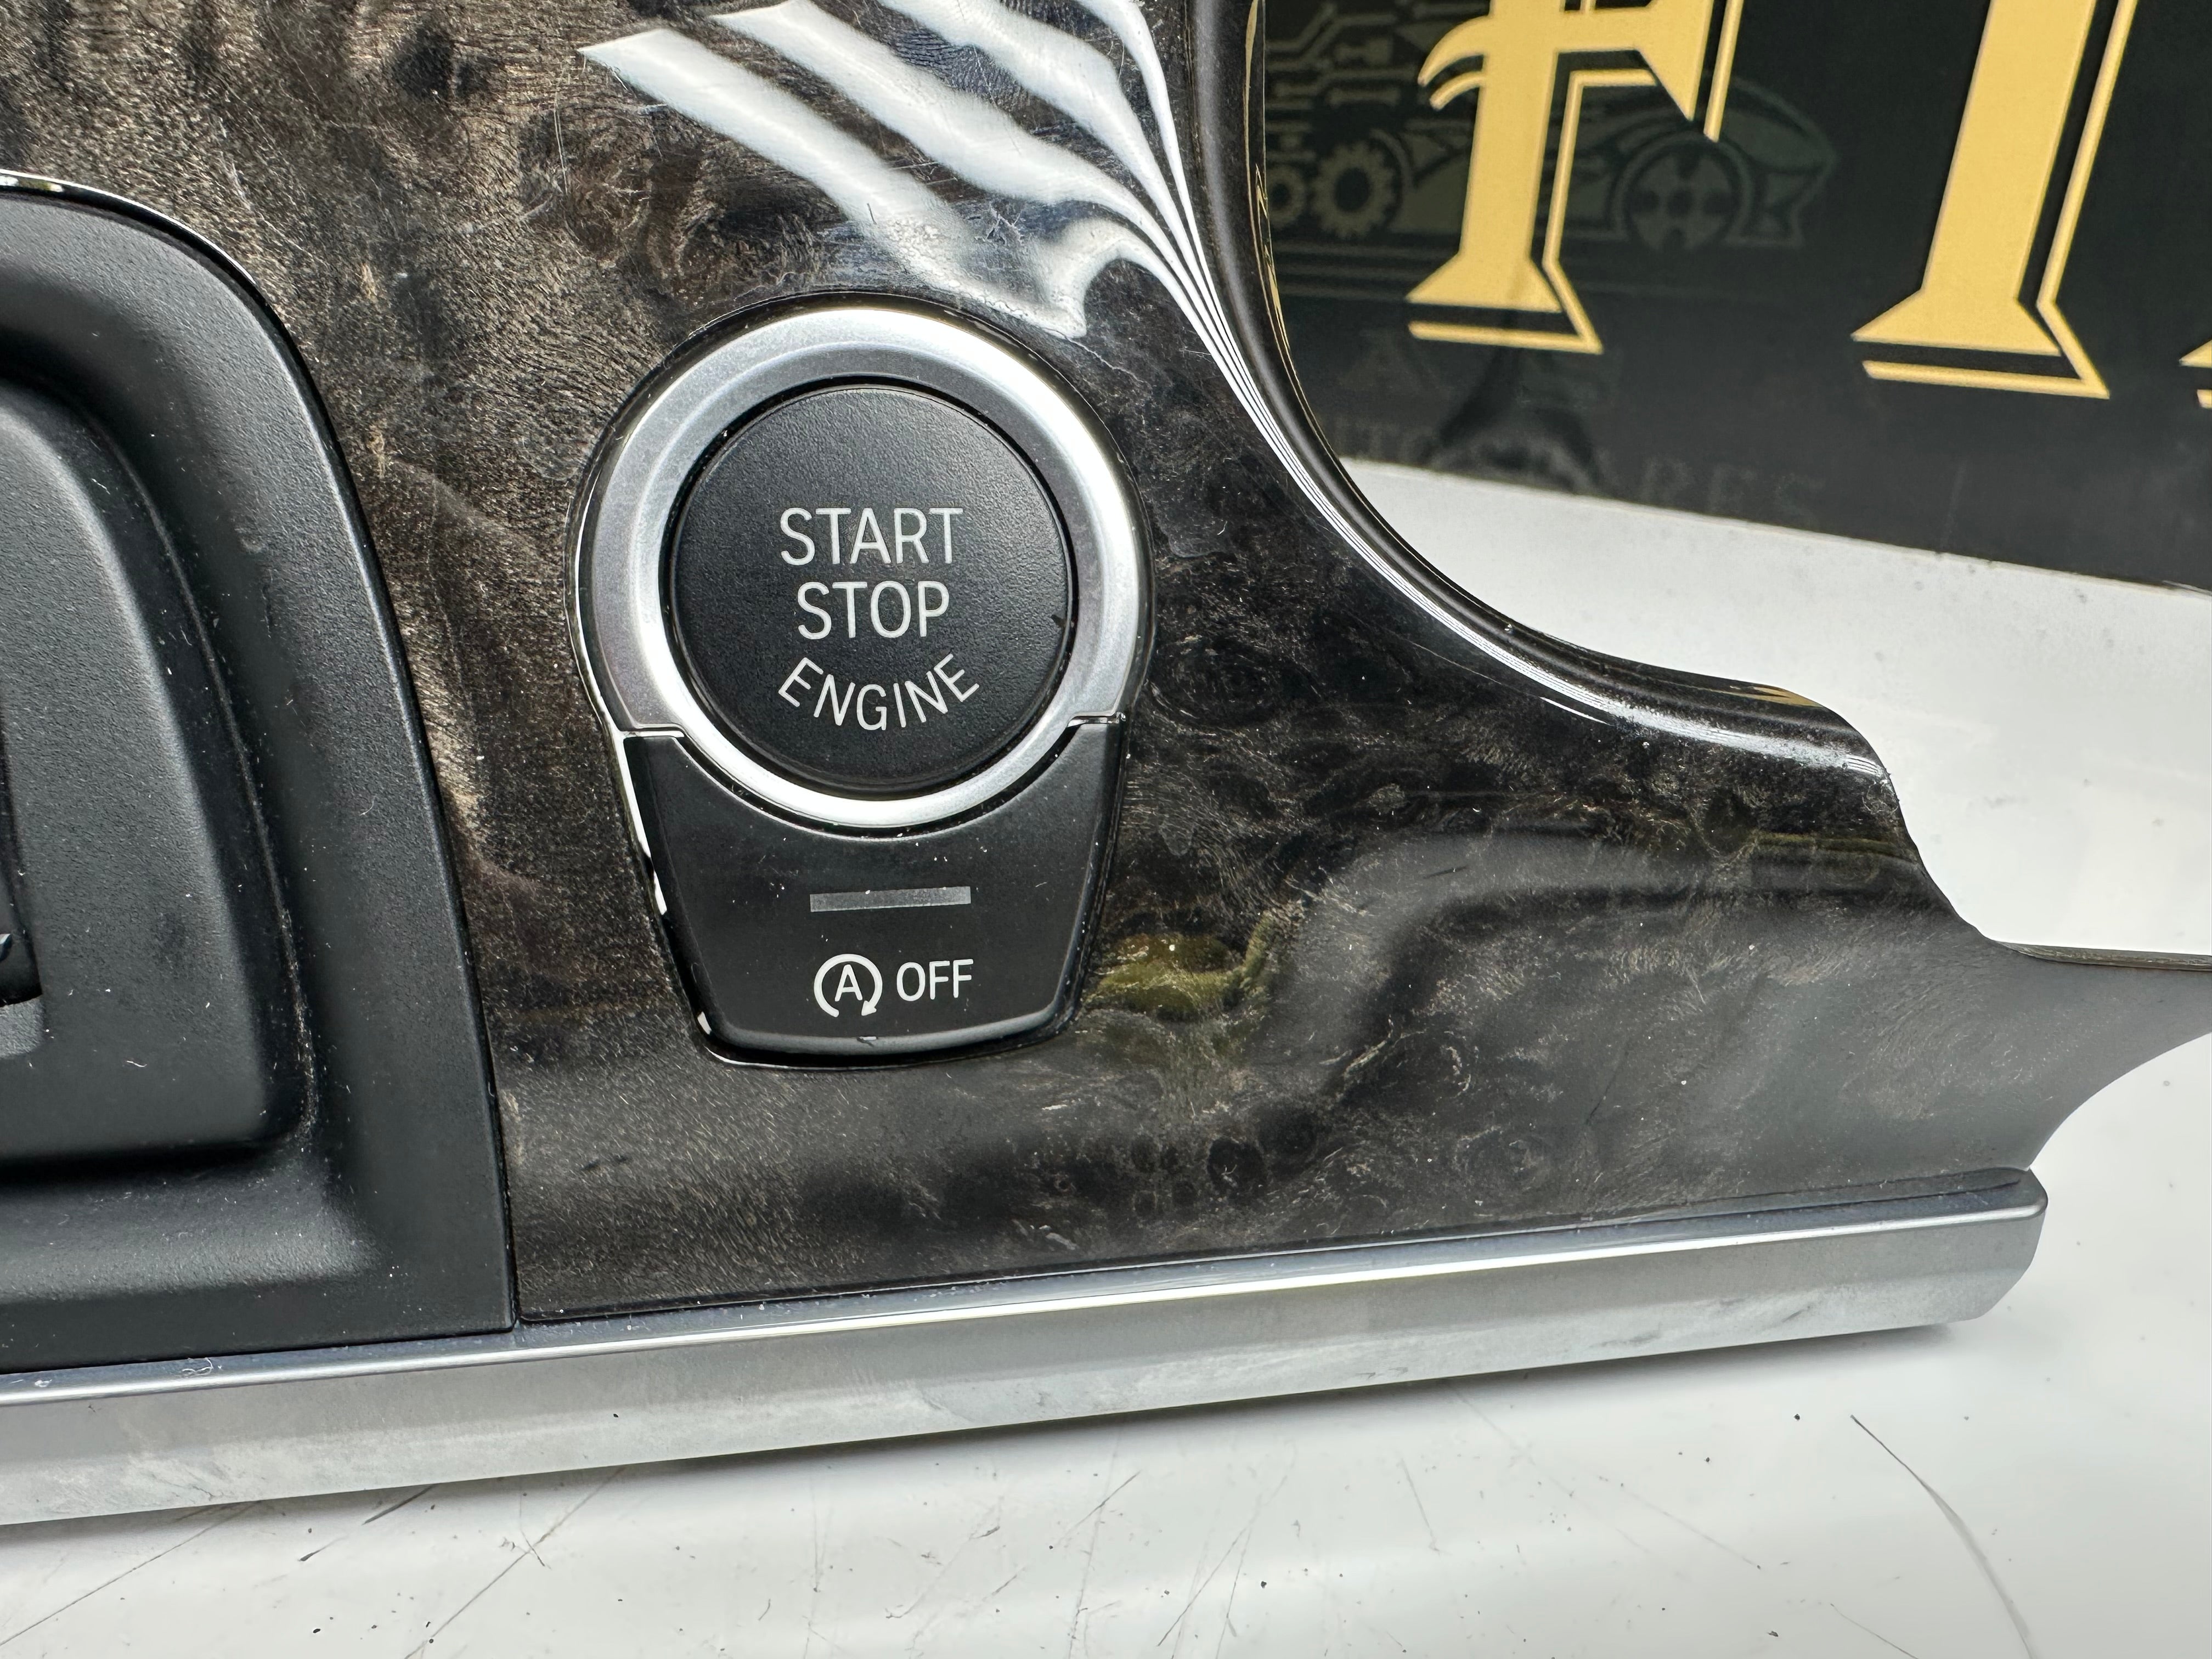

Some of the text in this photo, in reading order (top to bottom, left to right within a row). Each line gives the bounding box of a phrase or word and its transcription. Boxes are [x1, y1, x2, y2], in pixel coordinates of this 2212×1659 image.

[780, 507, 963, 566] START
[797, 580, 950, 640] STOP
[778, 653, 980, 731] ENGINE
[896, 958, 974, 1002] OFF
